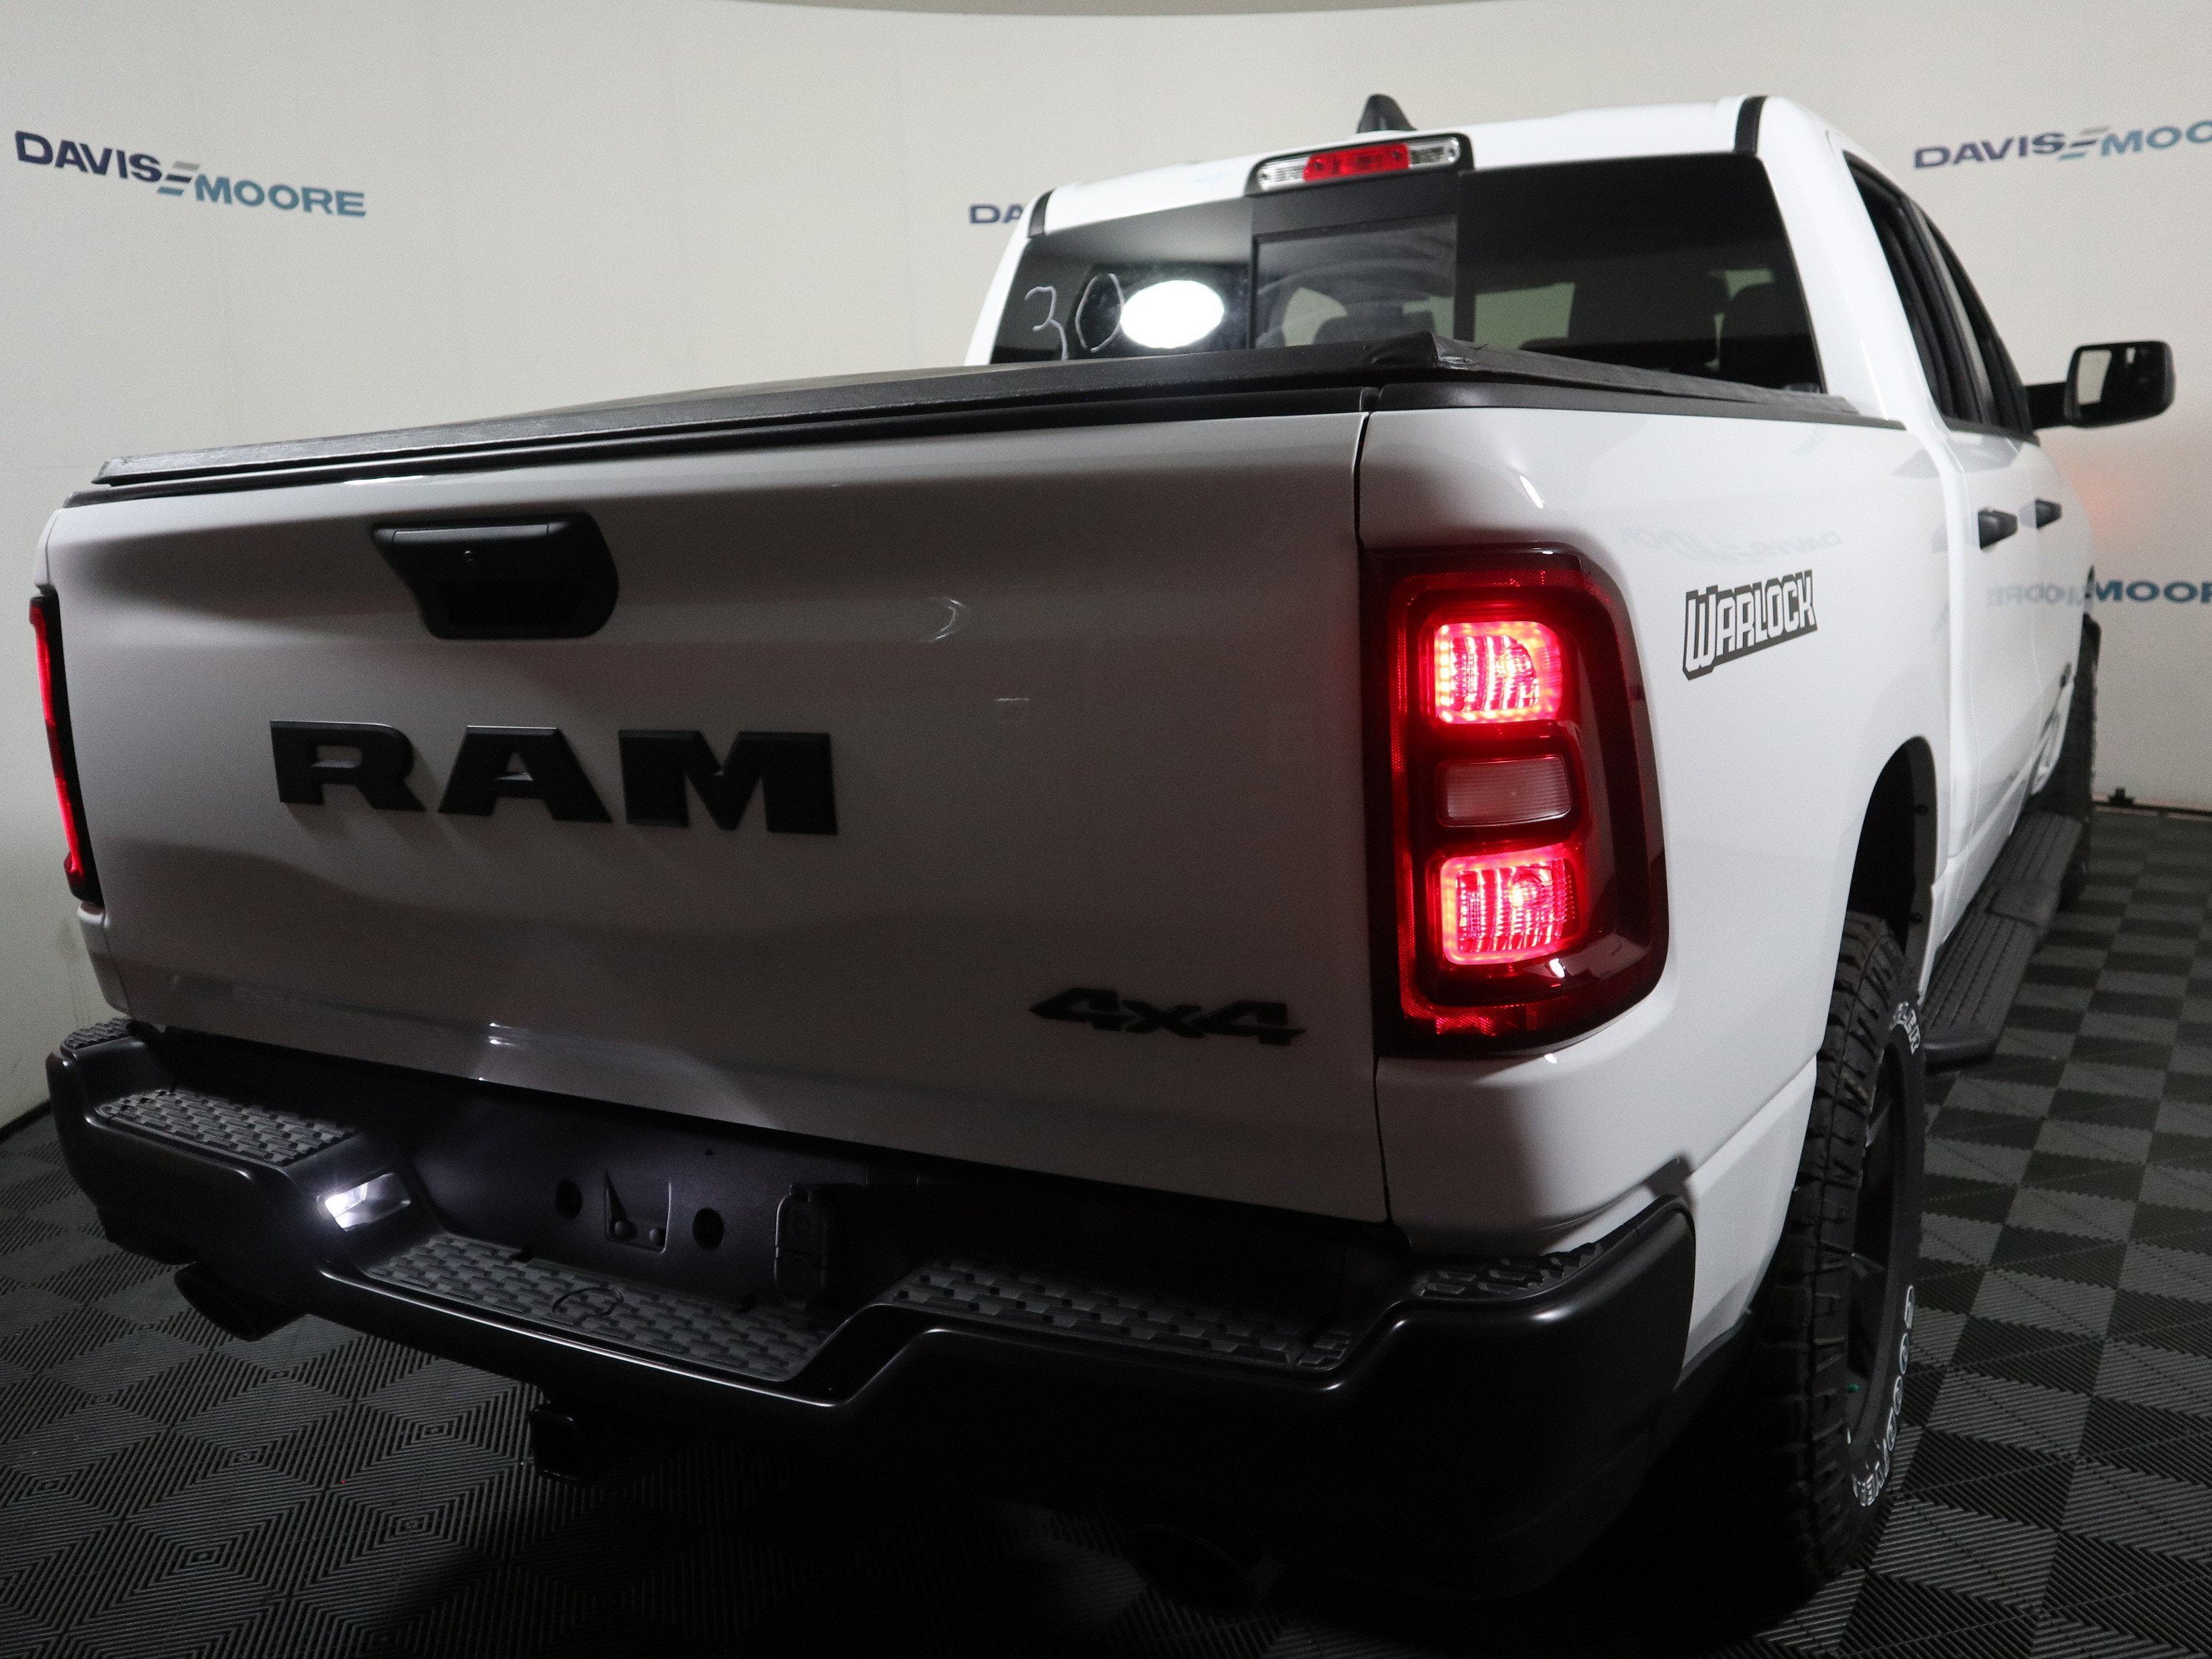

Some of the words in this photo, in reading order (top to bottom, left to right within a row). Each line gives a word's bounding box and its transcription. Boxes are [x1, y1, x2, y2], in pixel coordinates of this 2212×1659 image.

[15, 130, 164, 184] DAVIS
[195, 173, 367, 218] MOORE
[1914, 132, 2067, 170] DAVIS
[1682, 569, 1818, 681] WARLOCK
[270, 720, 837, 835] RAM
